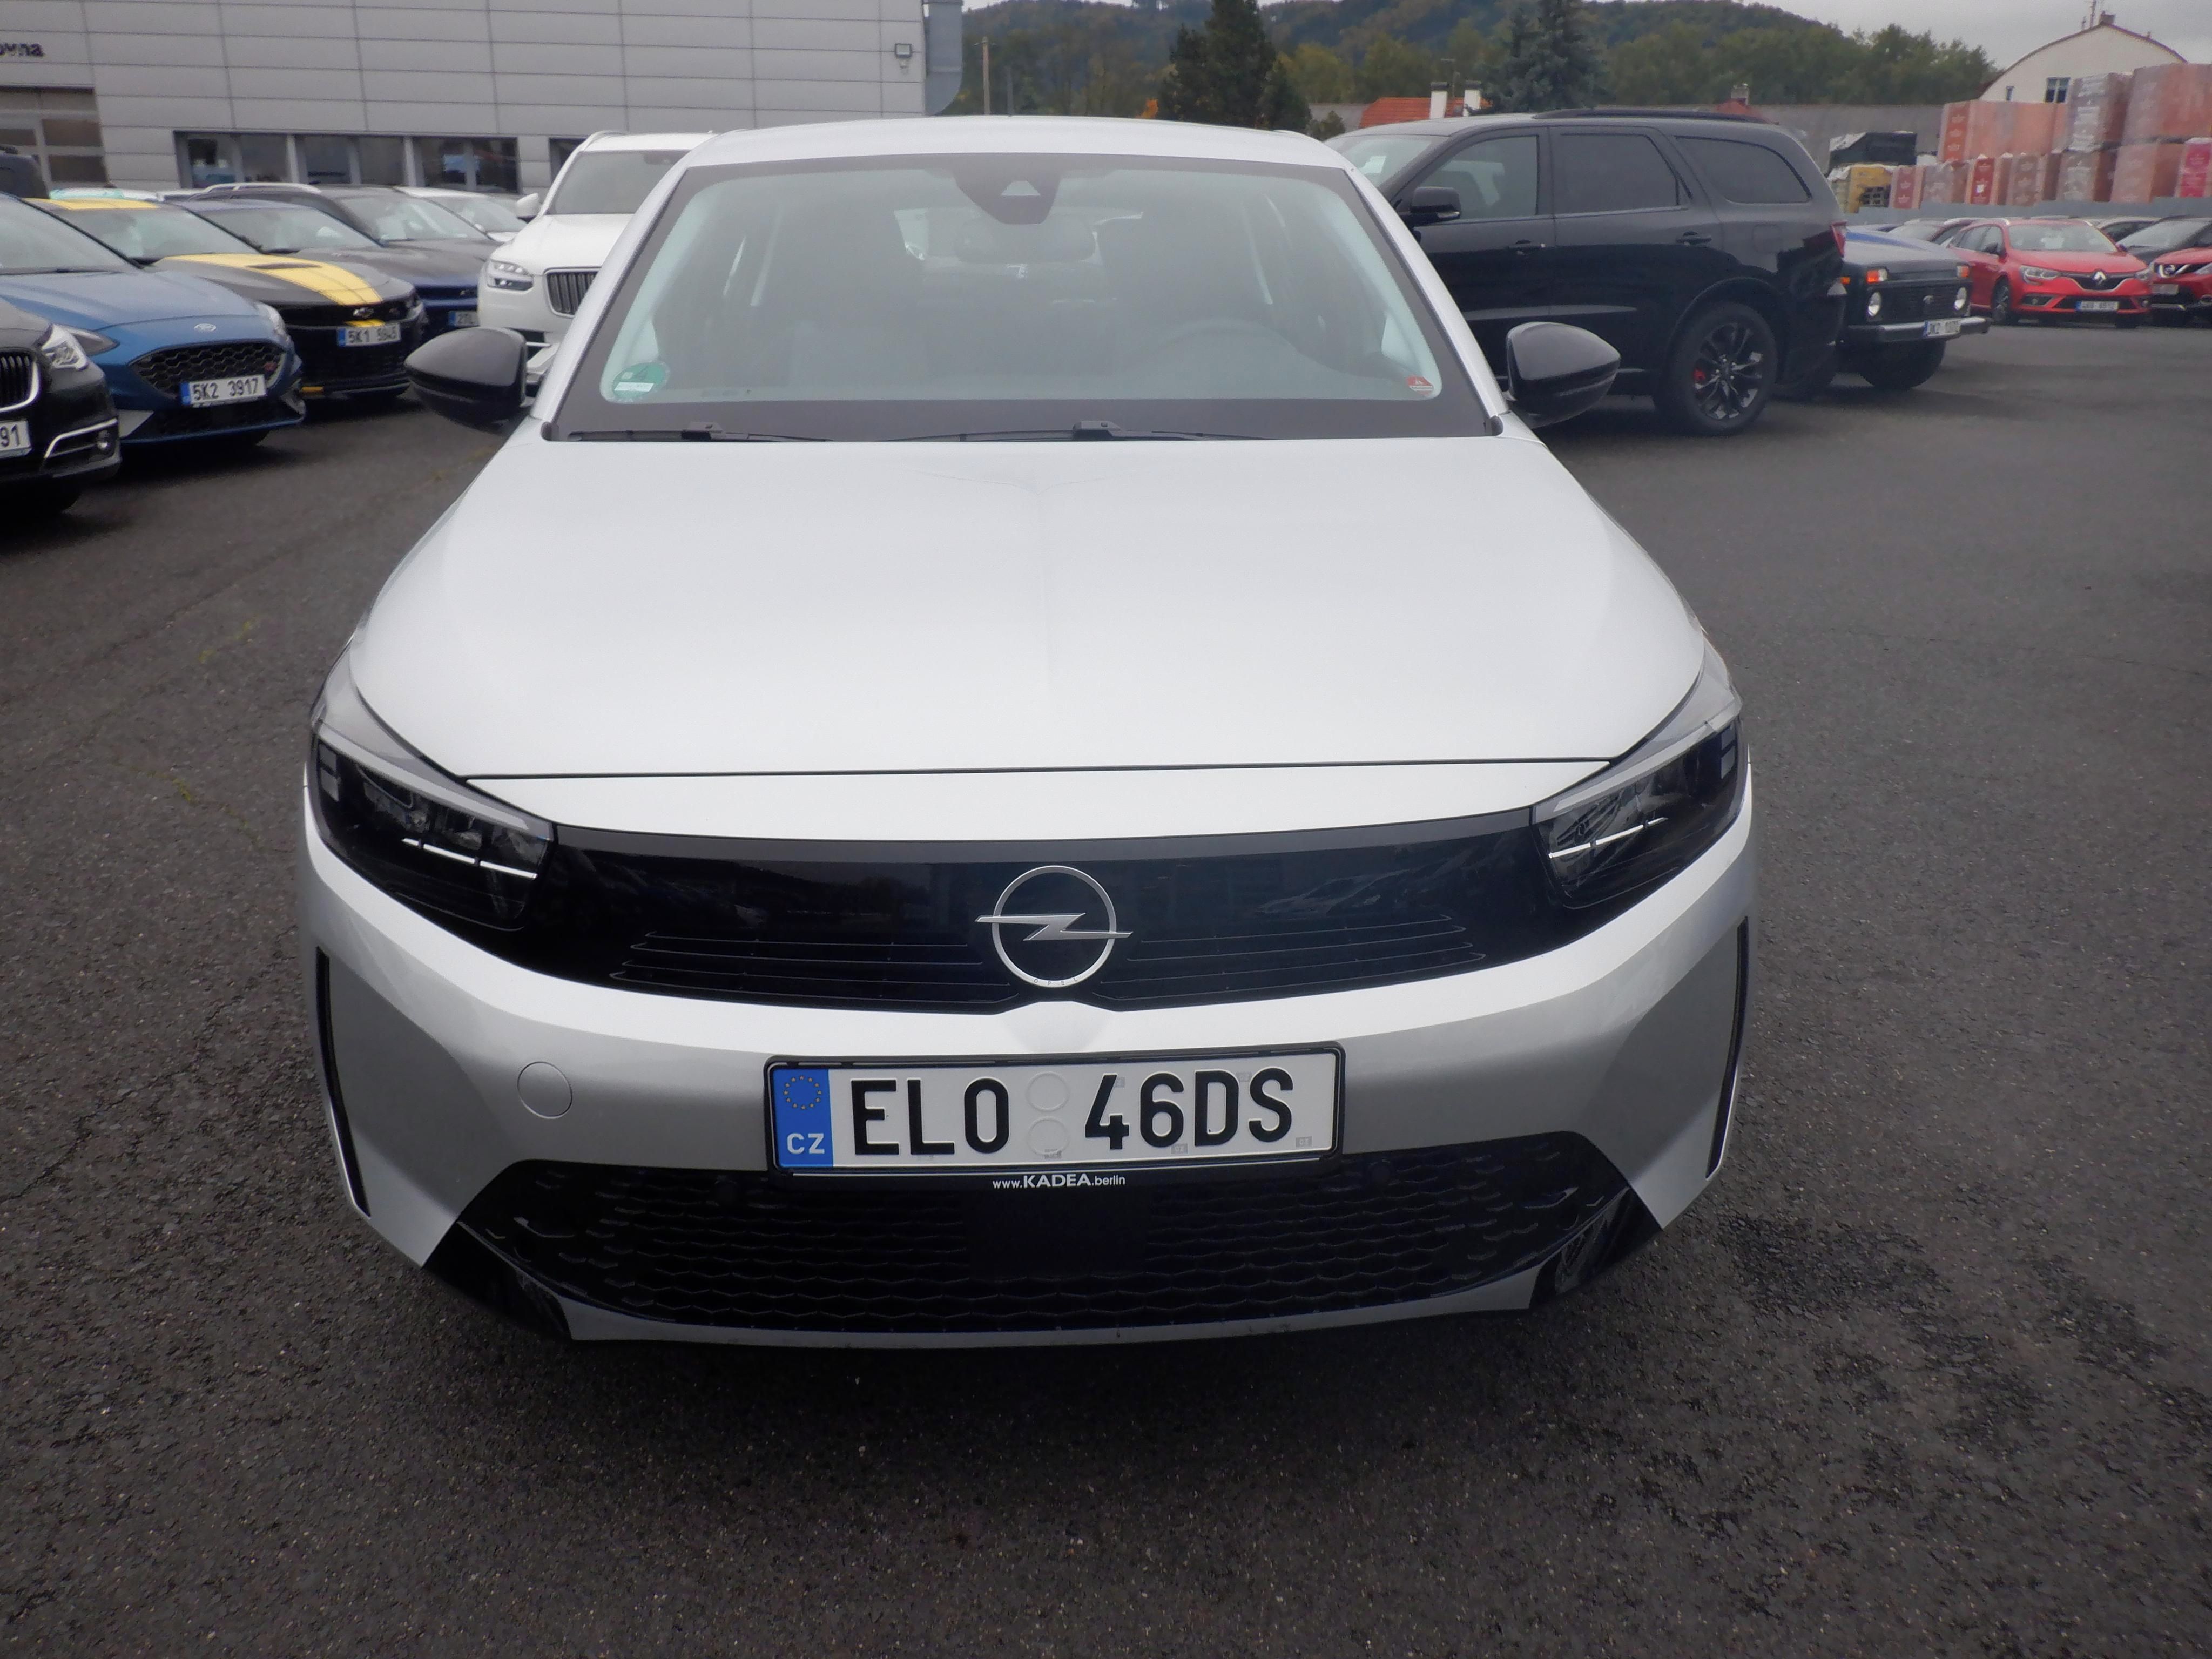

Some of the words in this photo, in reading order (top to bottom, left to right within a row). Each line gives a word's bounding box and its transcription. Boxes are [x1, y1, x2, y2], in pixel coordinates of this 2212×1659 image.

[192, 382, 219, 400] 5K2
[227, 377, 259, 396] 3917
[0, 424, 20, 448] 91
[1034, 977, 1078, 986] OPEL
[1084, 1067, 1293, 1150] 46DS
[786, 1132, 825, 1154] CZ
[993, 1173, 1125, 1189] www.KADEA.berlin
